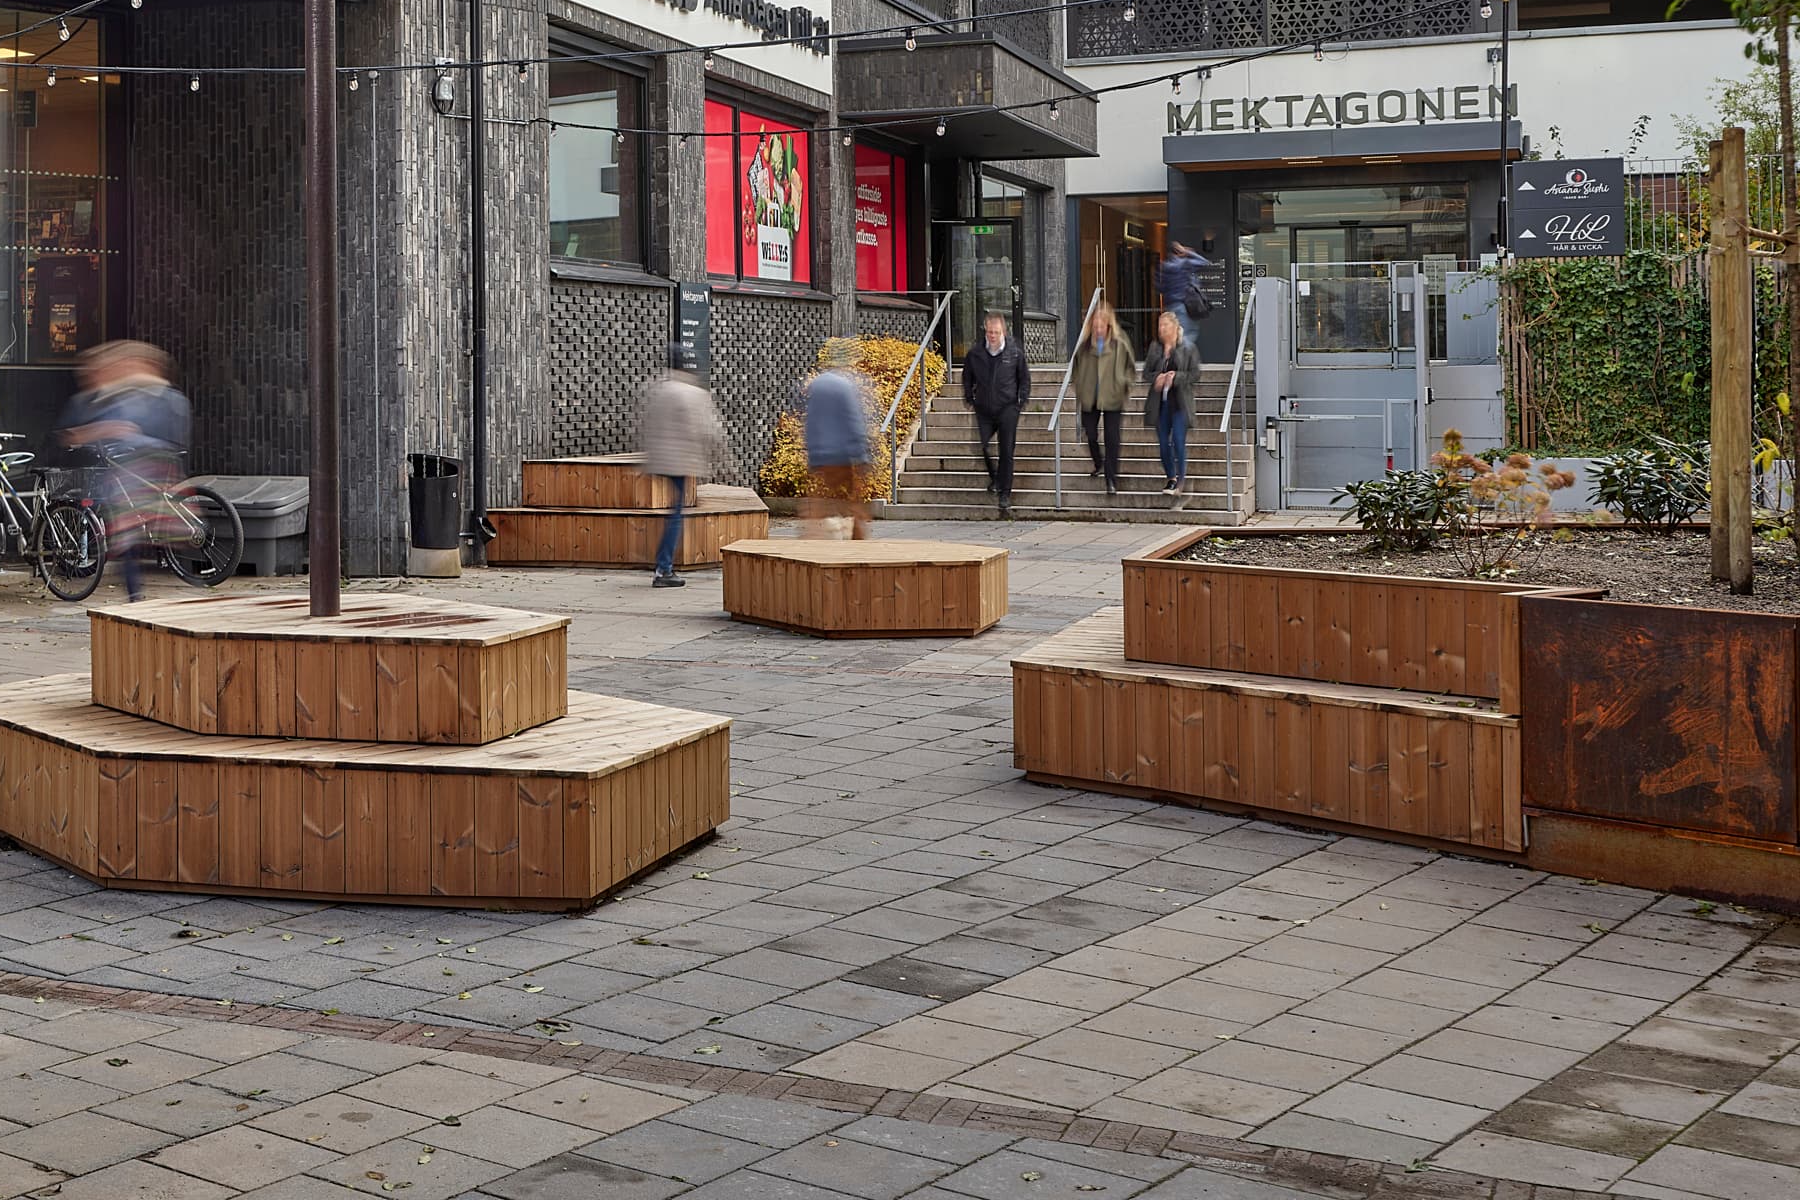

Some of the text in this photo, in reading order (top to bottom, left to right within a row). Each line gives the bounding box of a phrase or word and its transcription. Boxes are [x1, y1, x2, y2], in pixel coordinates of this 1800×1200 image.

[1166, 82, 1519, 133] MEKTAGONEN
[1583, 182, 1610, 196] Sushi
[1578, 243, 1603, 251] LYCKA
